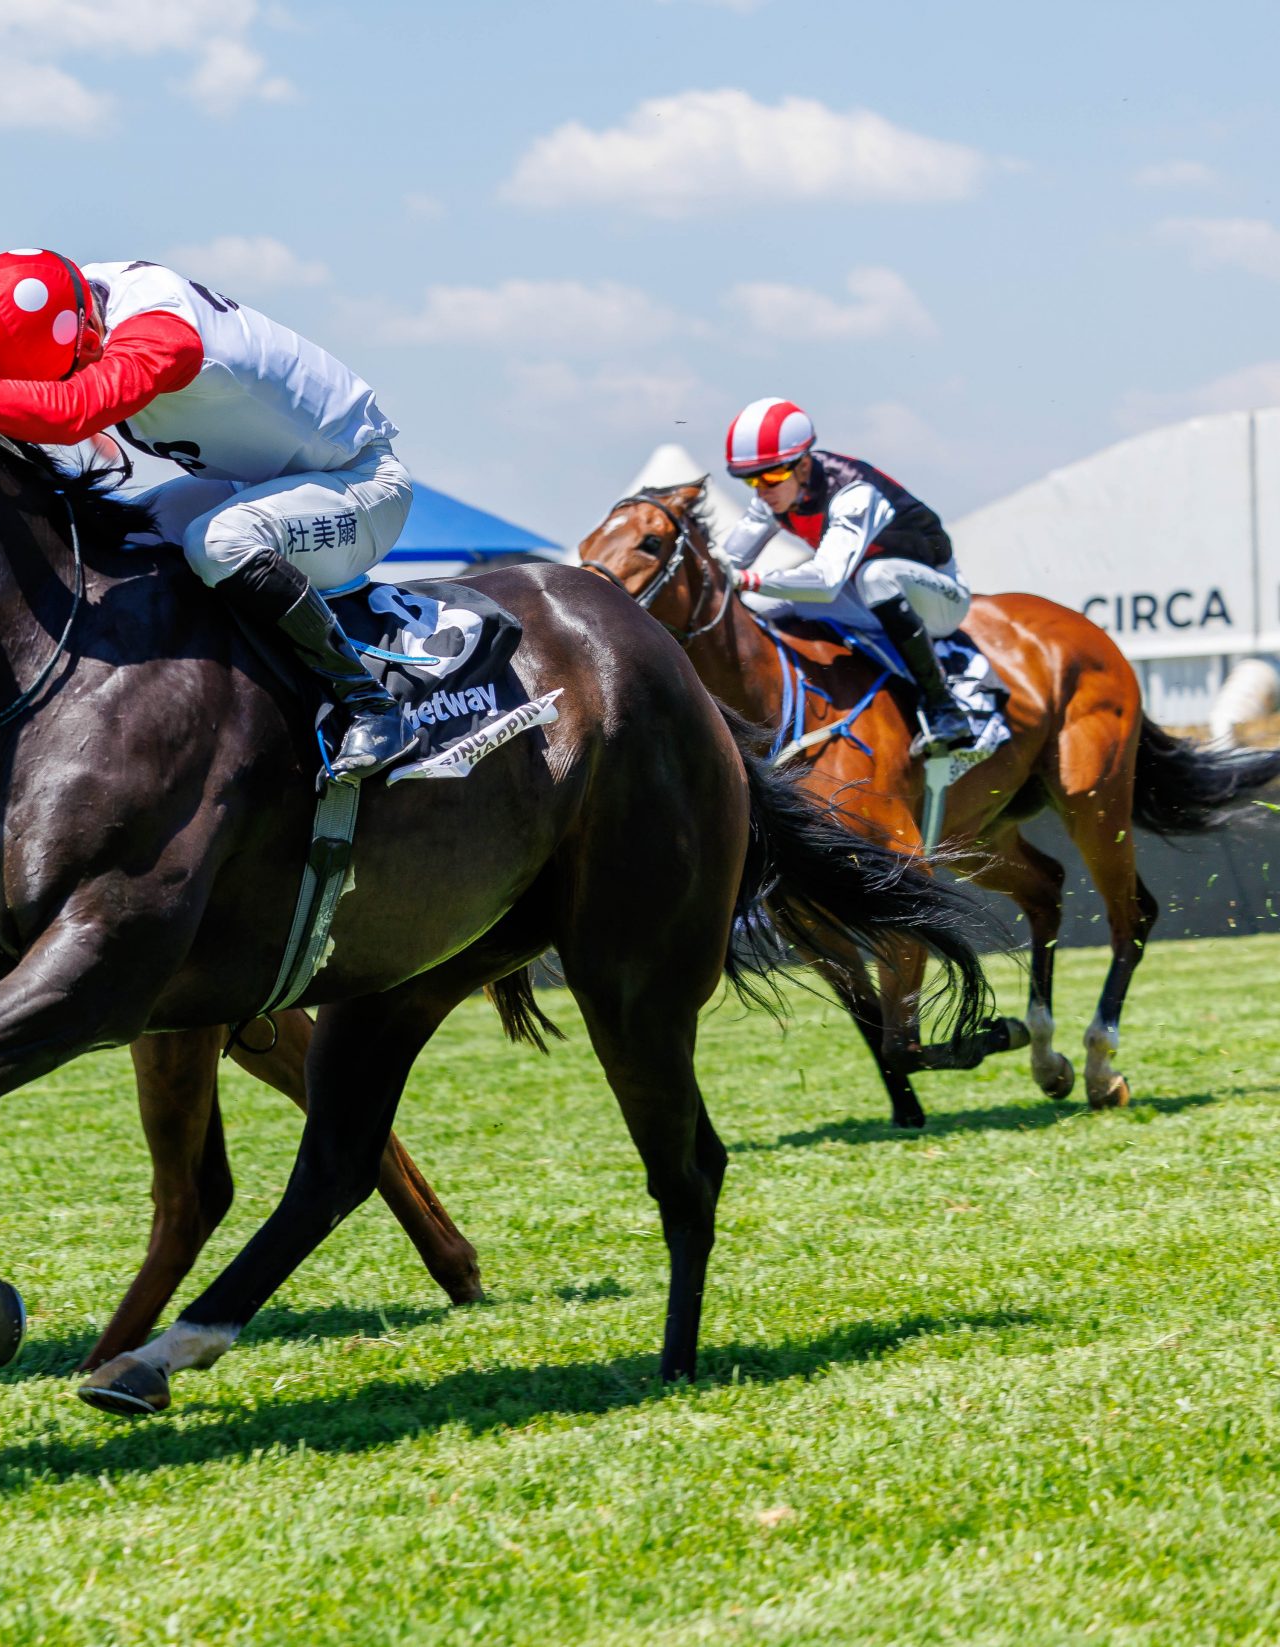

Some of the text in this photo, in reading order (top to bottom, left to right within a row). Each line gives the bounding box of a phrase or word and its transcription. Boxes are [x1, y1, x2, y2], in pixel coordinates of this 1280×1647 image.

[287, 512, 357, 554] 杜美爾
[1082, 586, 1232, 632] CIRCA
[403, 683, 498, 731] betway
